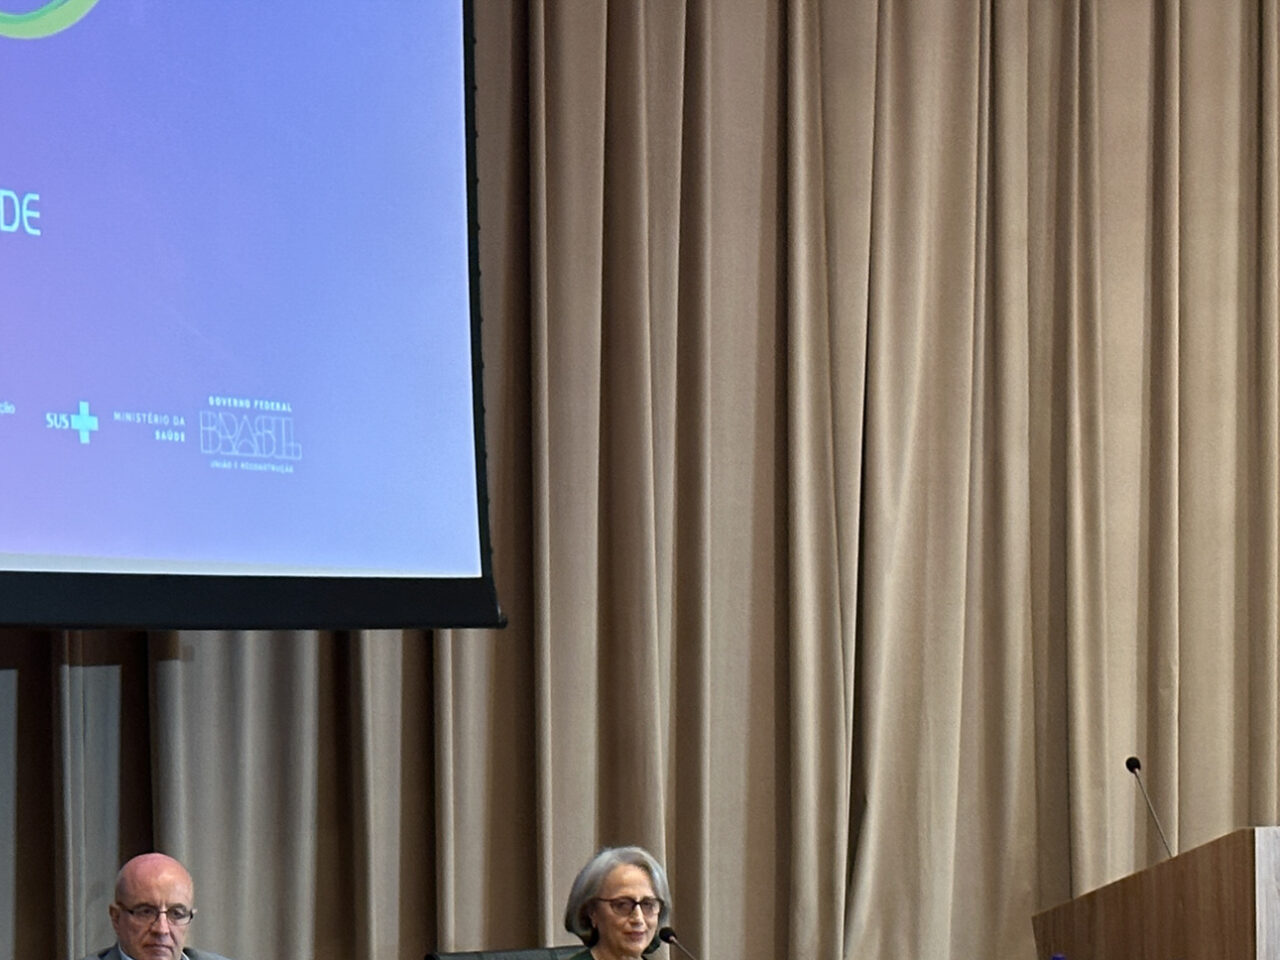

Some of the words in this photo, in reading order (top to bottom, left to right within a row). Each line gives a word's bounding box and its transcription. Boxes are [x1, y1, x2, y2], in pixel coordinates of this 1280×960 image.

[46, 412, 69, 429] SUS
[113, 410, 170, 426] MINISTÉRIO
[173, 415, 186, 427] DA
[155, 429, 186, 443] SAÚDE
[199, 411, 303, 461] BRASIL
